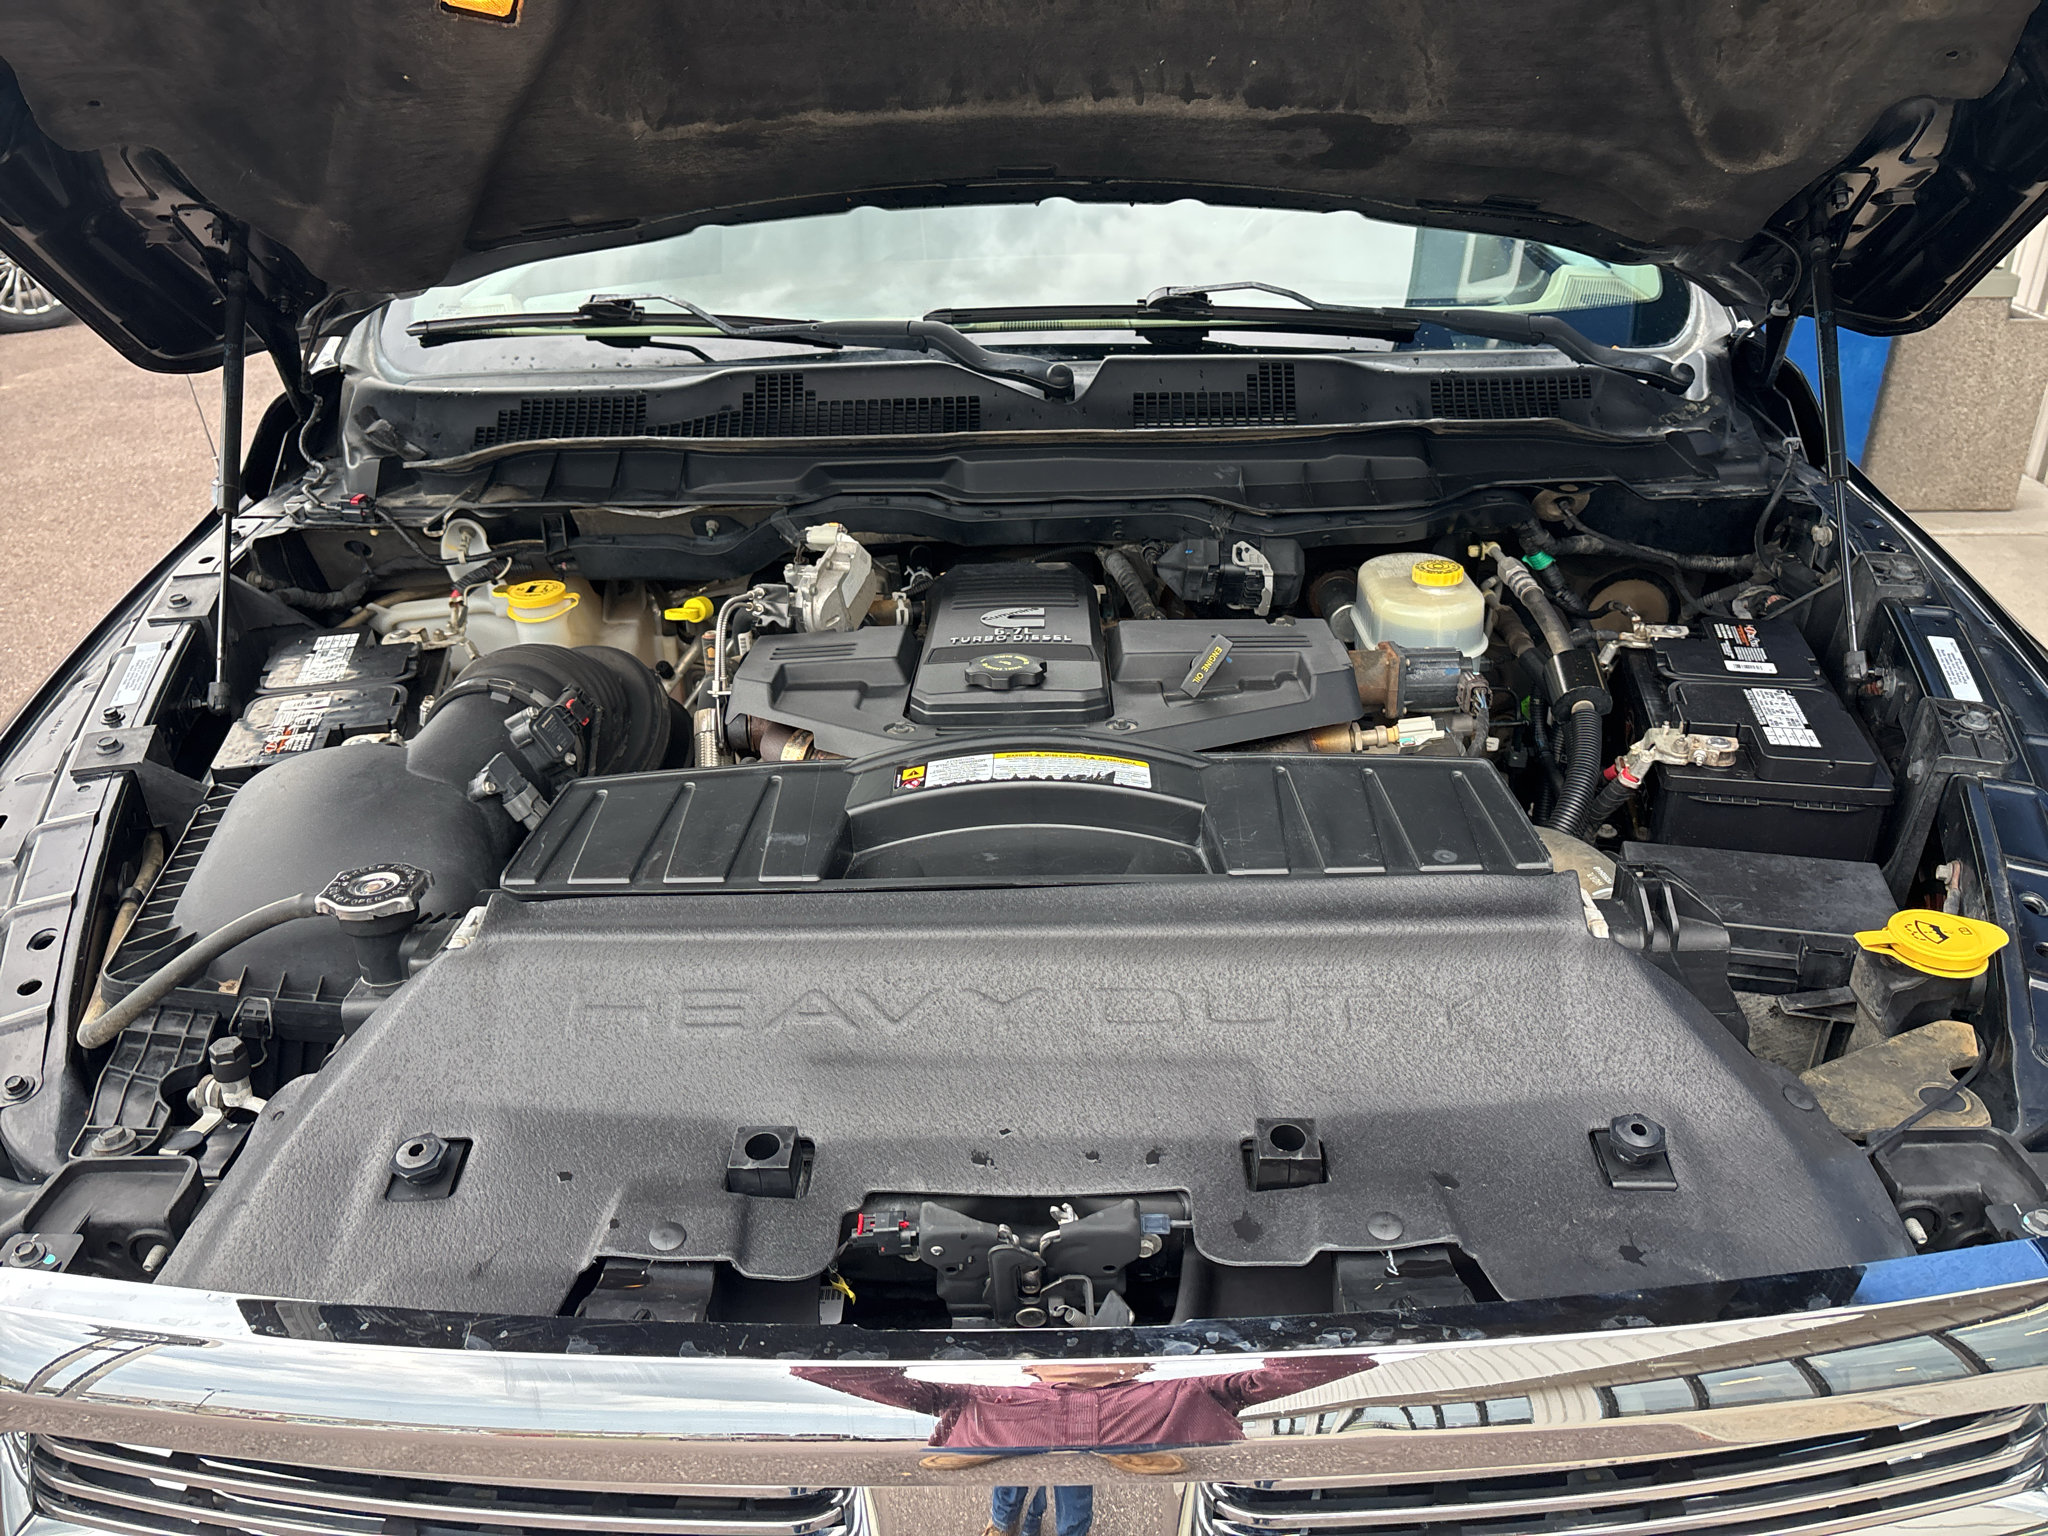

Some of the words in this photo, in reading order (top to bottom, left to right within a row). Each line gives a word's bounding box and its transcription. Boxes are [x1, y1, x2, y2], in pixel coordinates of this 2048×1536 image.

[994, 627, 1033, 636] 6.7L
[950, 635, 1007, 644] TURBO
[1013, 634, 1073, 643] DIESEL
[1201, 646, 1223, 673] ENGINE
[1192, 672, 1204, 684] OIL
[565, 983, 1046, 1034] HEAVY
[1090, 983, 1487, 1033] DUTY
